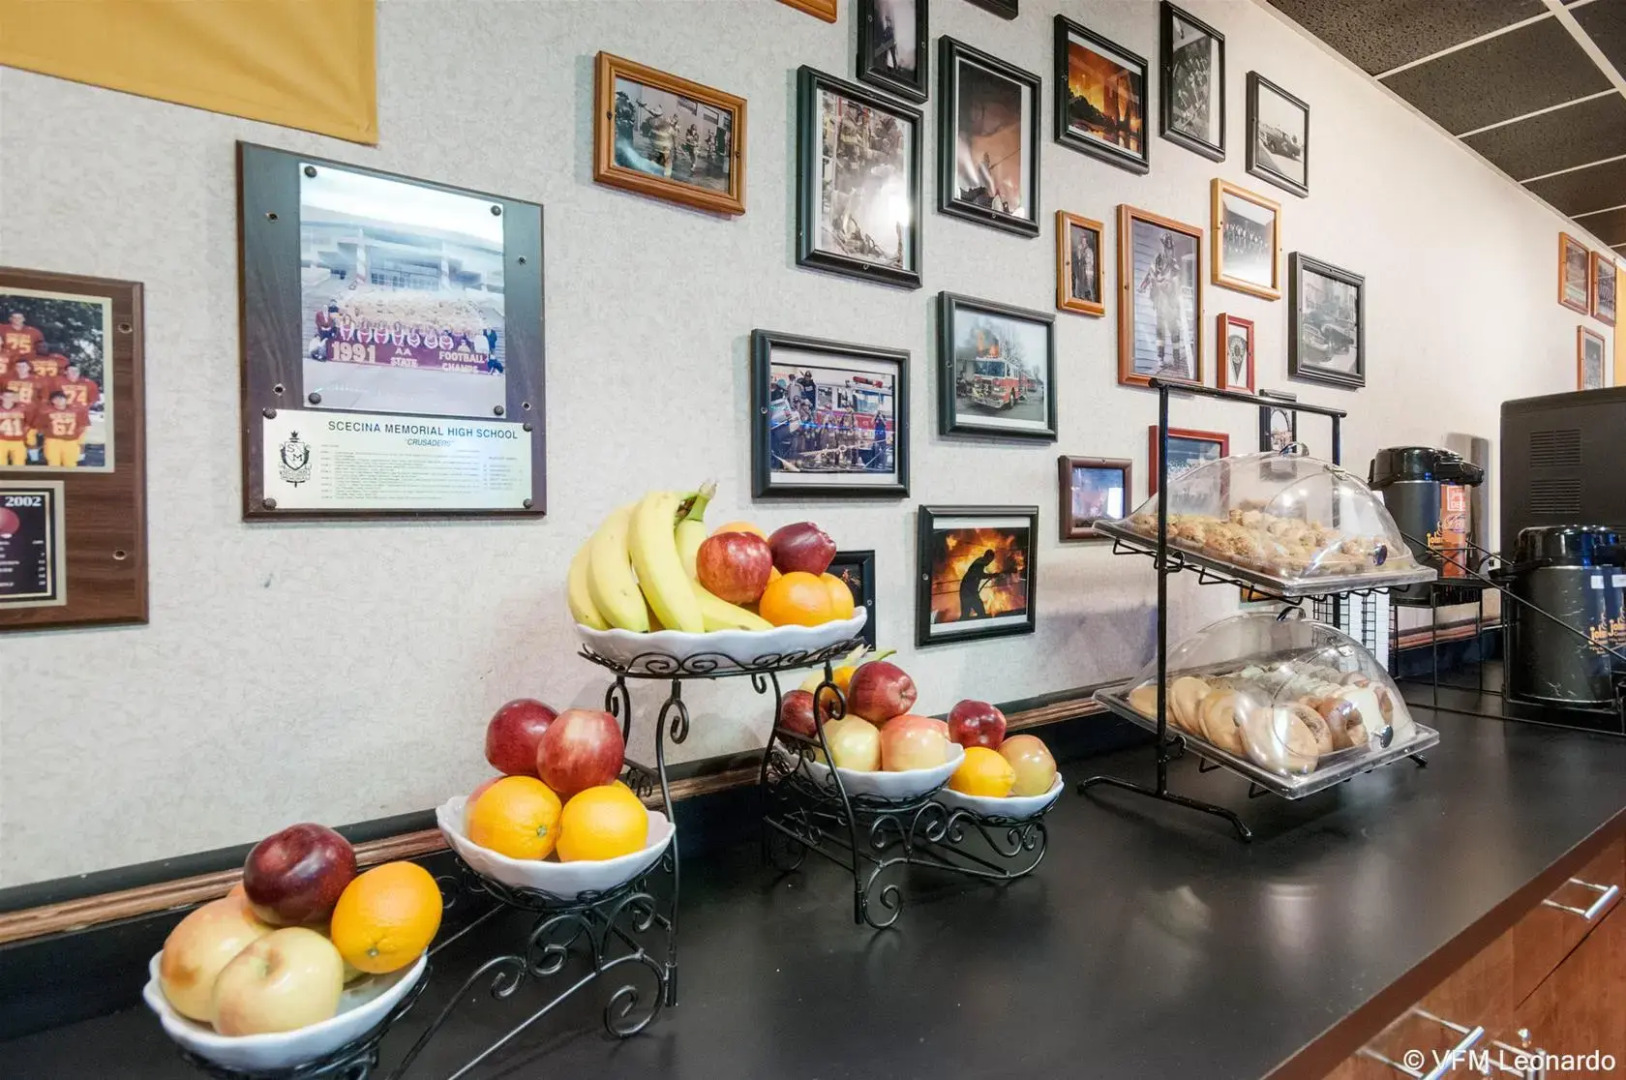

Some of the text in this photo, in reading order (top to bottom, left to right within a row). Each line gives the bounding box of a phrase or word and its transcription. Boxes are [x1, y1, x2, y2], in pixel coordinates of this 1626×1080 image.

[332, 341, 376, 363] 1991
[395, 347, 412, 356] AA
[439, 350, 485, 363] FOOTBALL
[328, 421, 518, 440] SCECINA MEMORIAL HIGH SCHOOL
[5, 496, 42, 507] 2002
